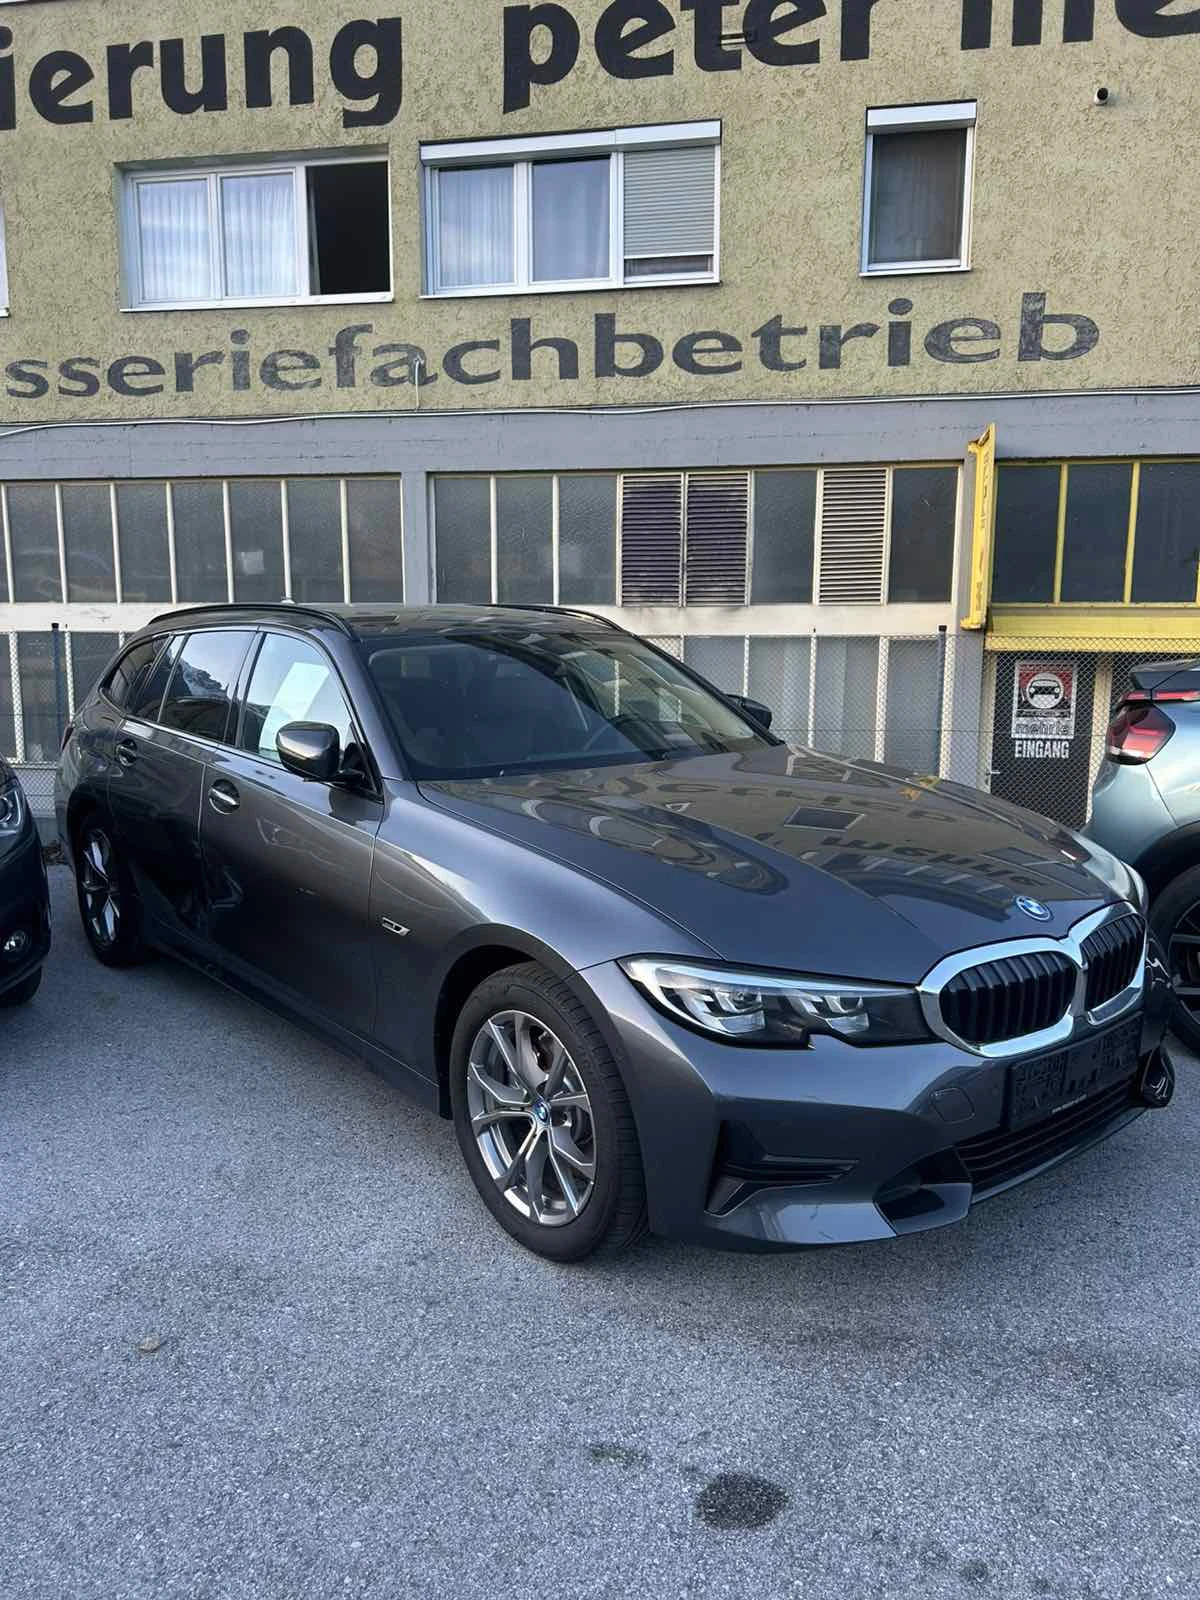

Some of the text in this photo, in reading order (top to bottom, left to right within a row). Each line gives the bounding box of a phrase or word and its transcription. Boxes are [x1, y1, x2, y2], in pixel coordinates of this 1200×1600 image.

[502, 0, 881, 114] peter
[5, 291, 1099, 399] sseriefachbetrieb
[1014, 740, 1070, 759] EINGANG
